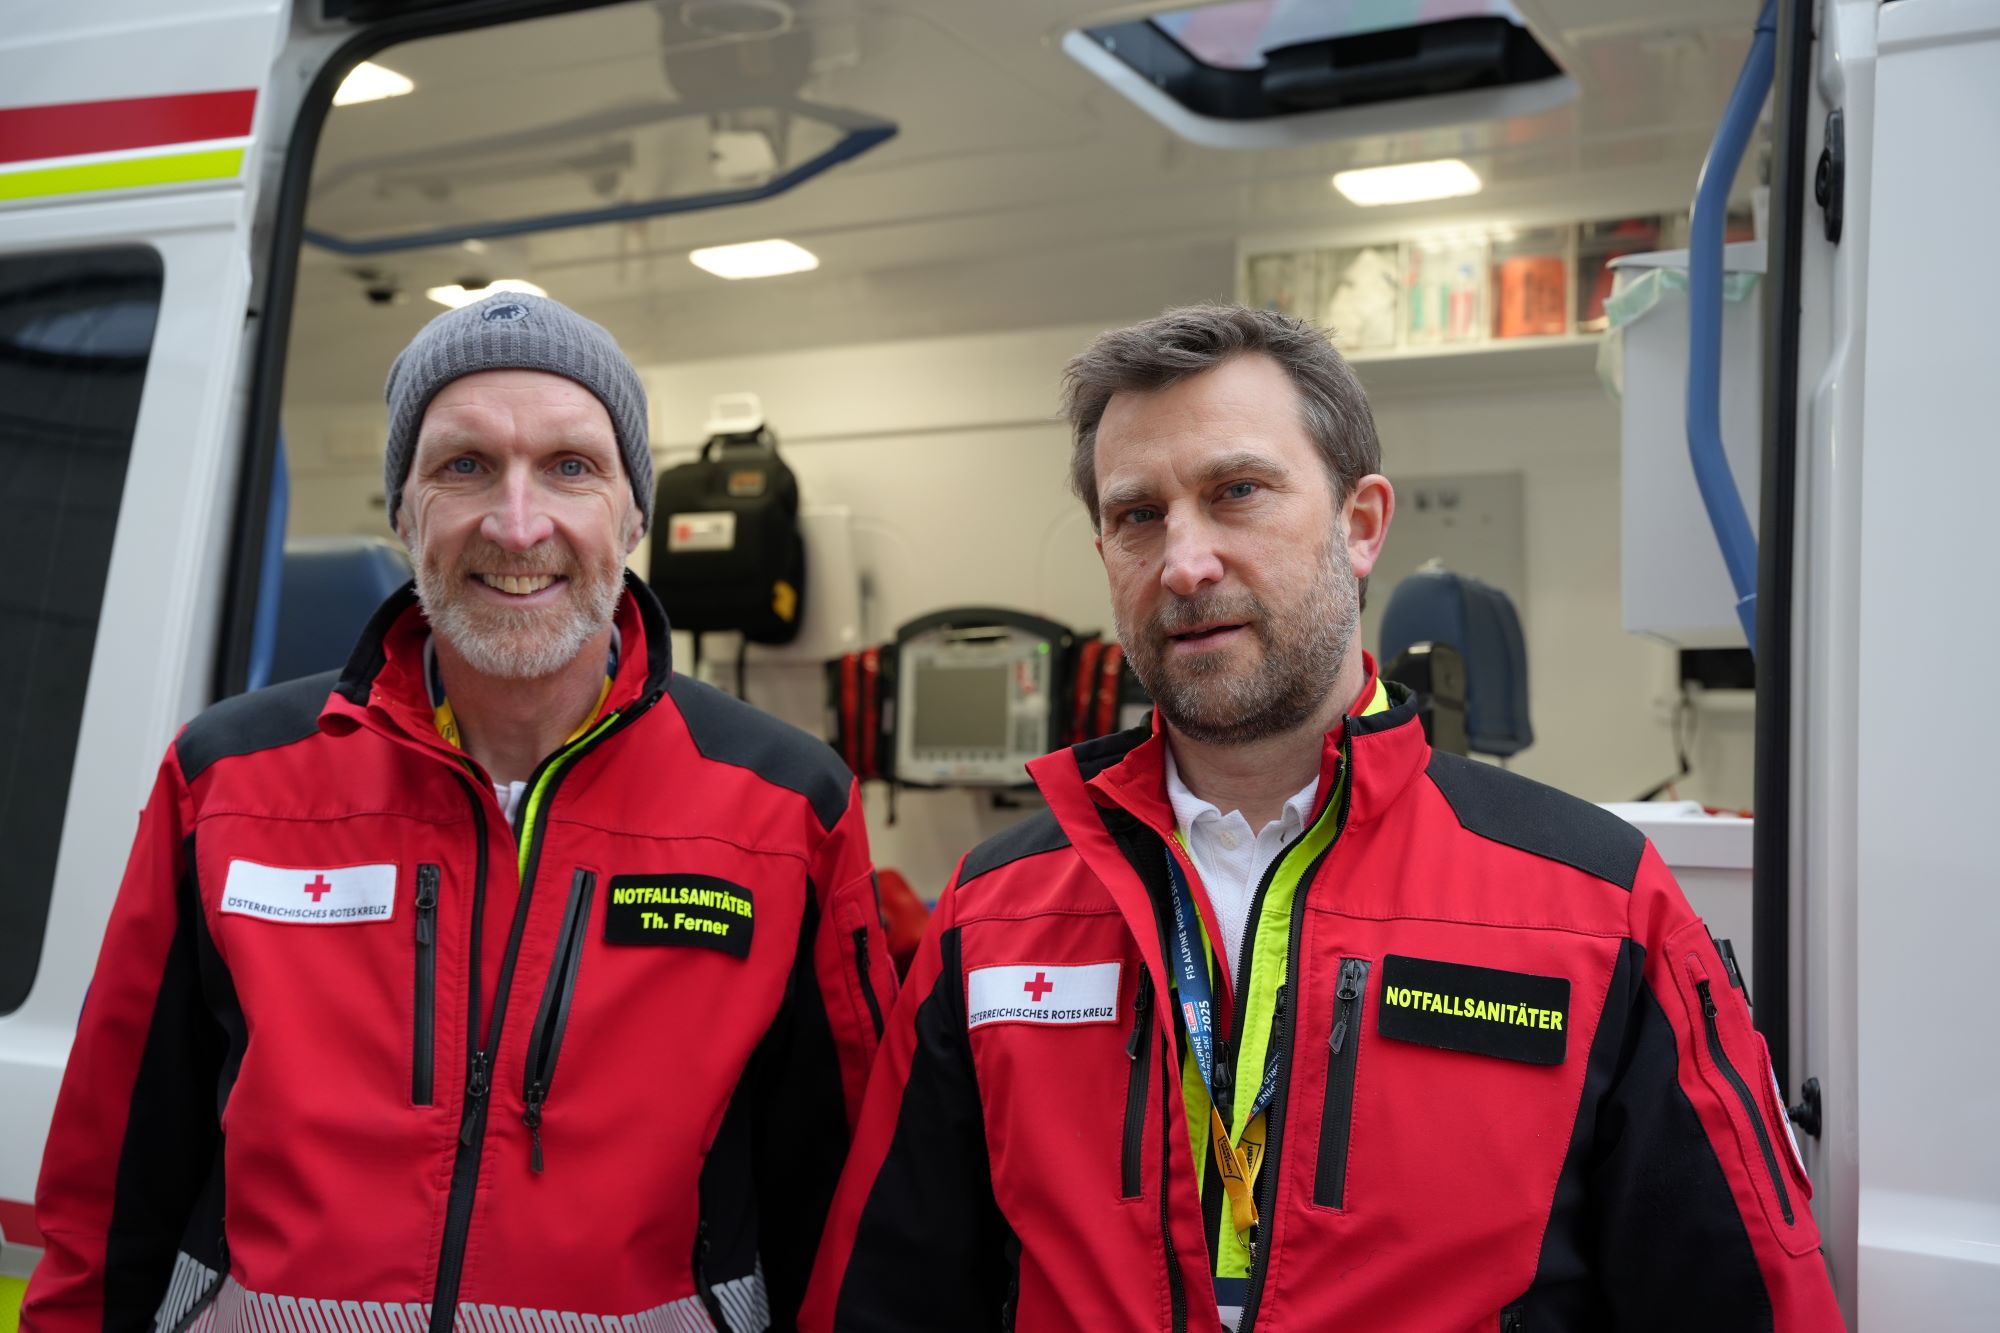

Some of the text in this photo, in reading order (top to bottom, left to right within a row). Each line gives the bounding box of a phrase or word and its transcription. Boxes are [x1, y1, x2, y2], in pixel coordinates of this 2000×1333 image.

[228, 896, 387, 919] ÖSTERREICHISCHES ROTES KREUZ
[613, 887, 752, 919] NOTFALLSANITÄTER
[1173, 896, 1185, 931] WORLD
[640, 912, 730, 936] Th. Ferner
[1178, 930, 1193, 963] ALPINE
[1184, 964, 1196, 980] FIS
[1051, 1009, 1082, 1020] ROTES
[1083, 1007, 1113, 1018] KREUZ
[1198, 1000, 1212, 1033] 2025
[1385, 985, 1563, 1031] NOTFALLSANITÄTER
[1193, 1036, 1207, 1069] ALPINE
[1202, 1035, 1210, 1050] SKI
